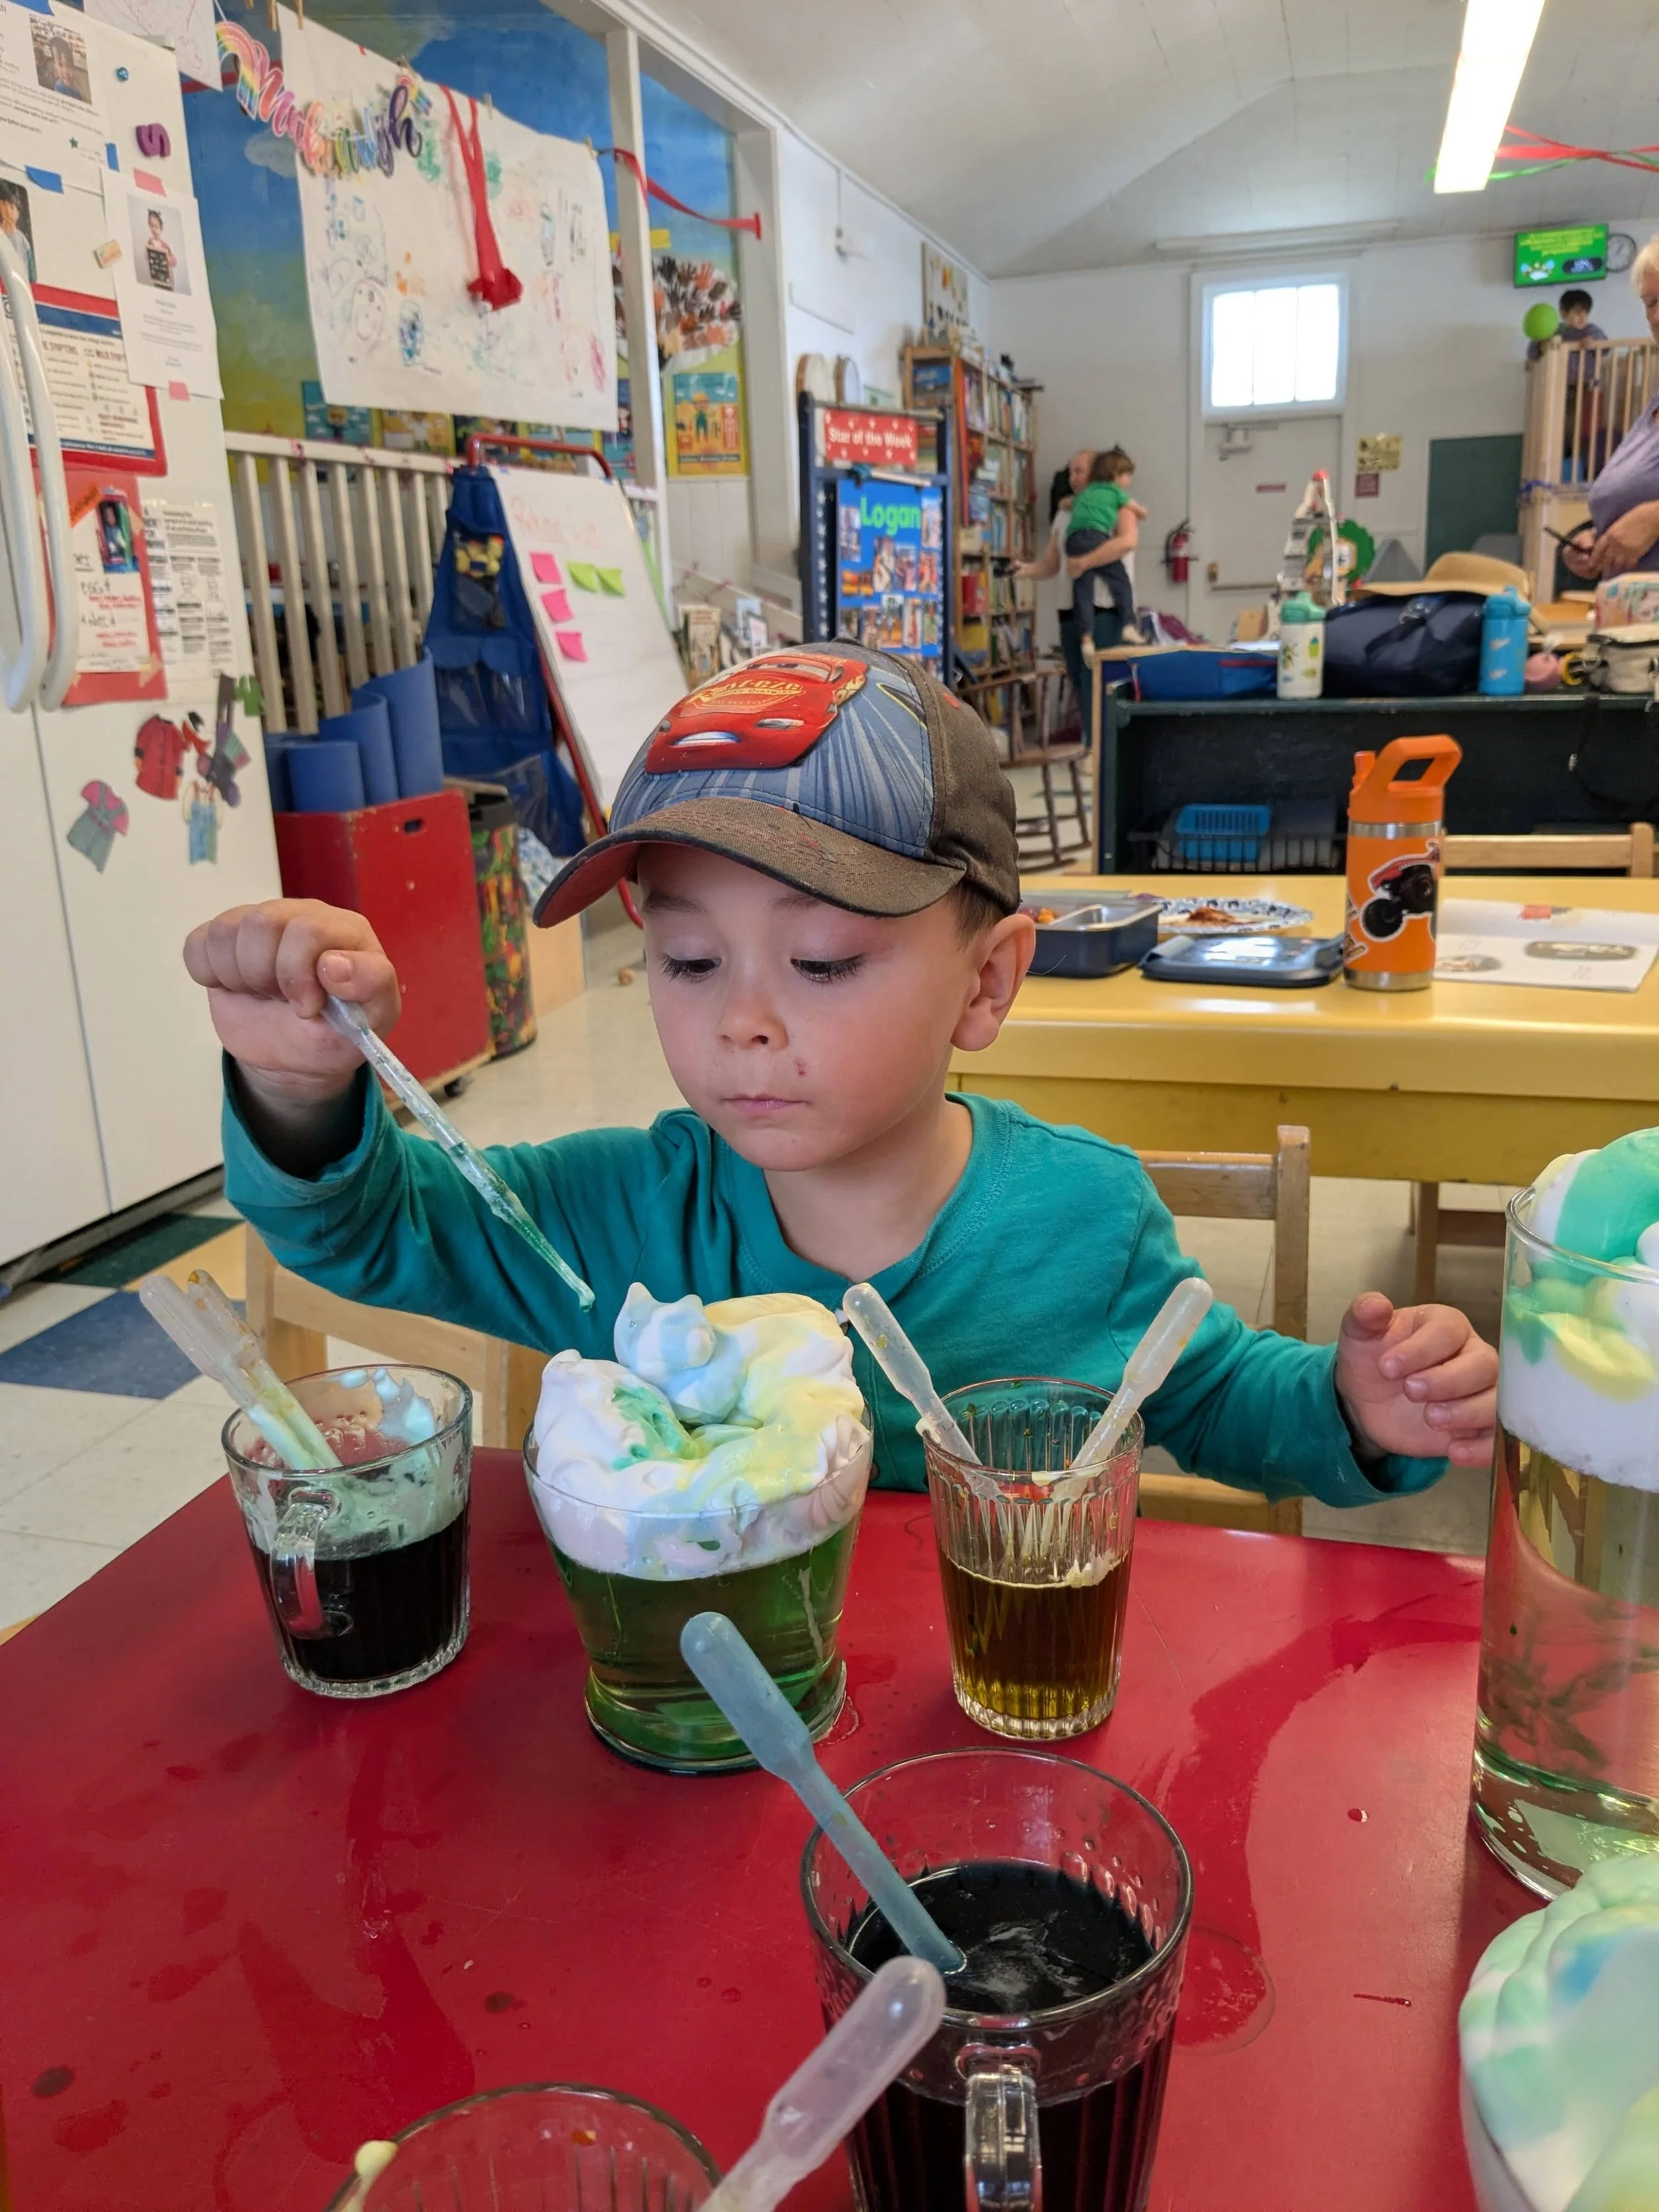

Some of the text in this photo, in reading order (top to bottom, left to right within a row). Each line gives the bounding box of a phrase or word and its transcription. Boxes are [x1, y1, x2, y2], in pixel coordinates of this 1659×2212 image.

[830, 427, 912, 449] Star of the Week
[860, 495, 922, 536] Logan
